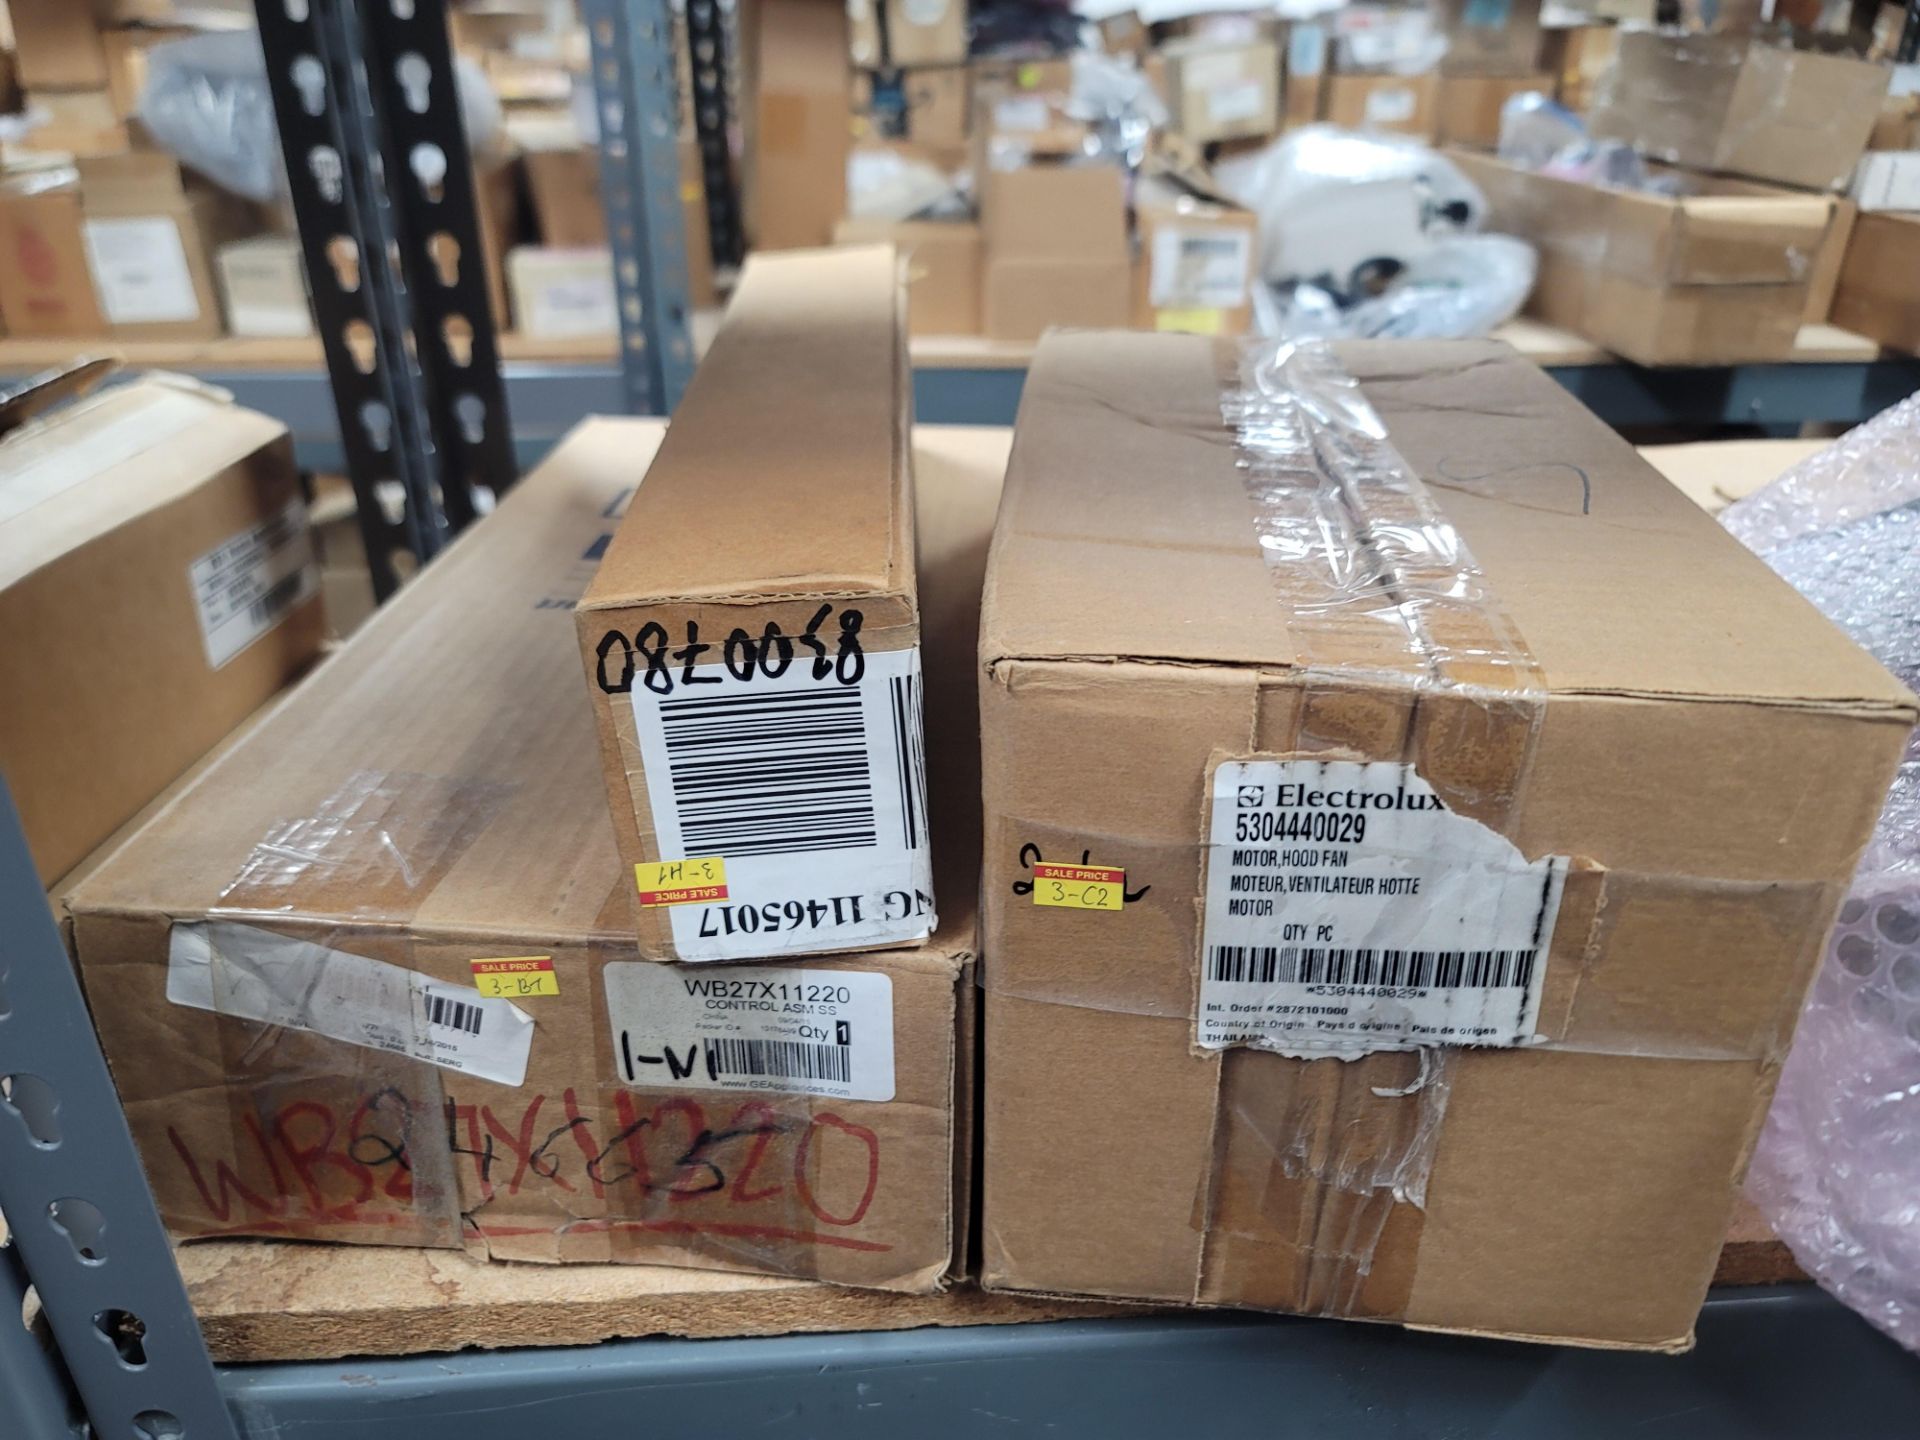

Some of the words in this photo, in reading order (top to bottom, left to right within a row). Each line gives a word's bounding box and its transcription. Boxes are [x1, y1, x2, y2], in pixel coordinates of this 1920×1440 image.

[1276, 784, 1443, 810] Electrolux
[1236, 812, 1365, 843] 5304440029
[1232, 850, 1319, 869] MOTOR,HOOD
[1322, 850, 1348, 867] FAN
[1045, 868, 1073, 879] SALE
[1076, 871, 1110, 881] PRICE
[689, 887, 719, 899] SALE
[1230, 874, 1374, 895] MOTEUR,VENTILATEUR
[1378, 877, 1421, 895] HOTTE
[655, 890, 688, 902] PRICE
[1051, 881, 1108, 907] 3-C2
[1228, 898, 1273, 916] MOTOR
[699, 894, 865, 938] 11465017
[1283, 923, 1309, 941] QTY
[1316, 925, 1334, 942] PC
[481, 963, 507, 973] SALE
[509, 962, 541, 971] PRICE
[684, 979, 851, 1004] WB27X11220
[705, 999, 779, 1013] CONTROL
[782, 1002, 815, 1014] ASM
[818, 1005, 838, 1016] SS
[1230, 1004, 1263, 1013] Order
[798, 1025, 829, 1042] Qty
[1206, 1020, 1249, 1031] Country
[1269, 1020, 1305, 1031] Origin
[1440, 1026, 1455, 1035] de
[1206, 1034, 1264, 1042] THAILA
